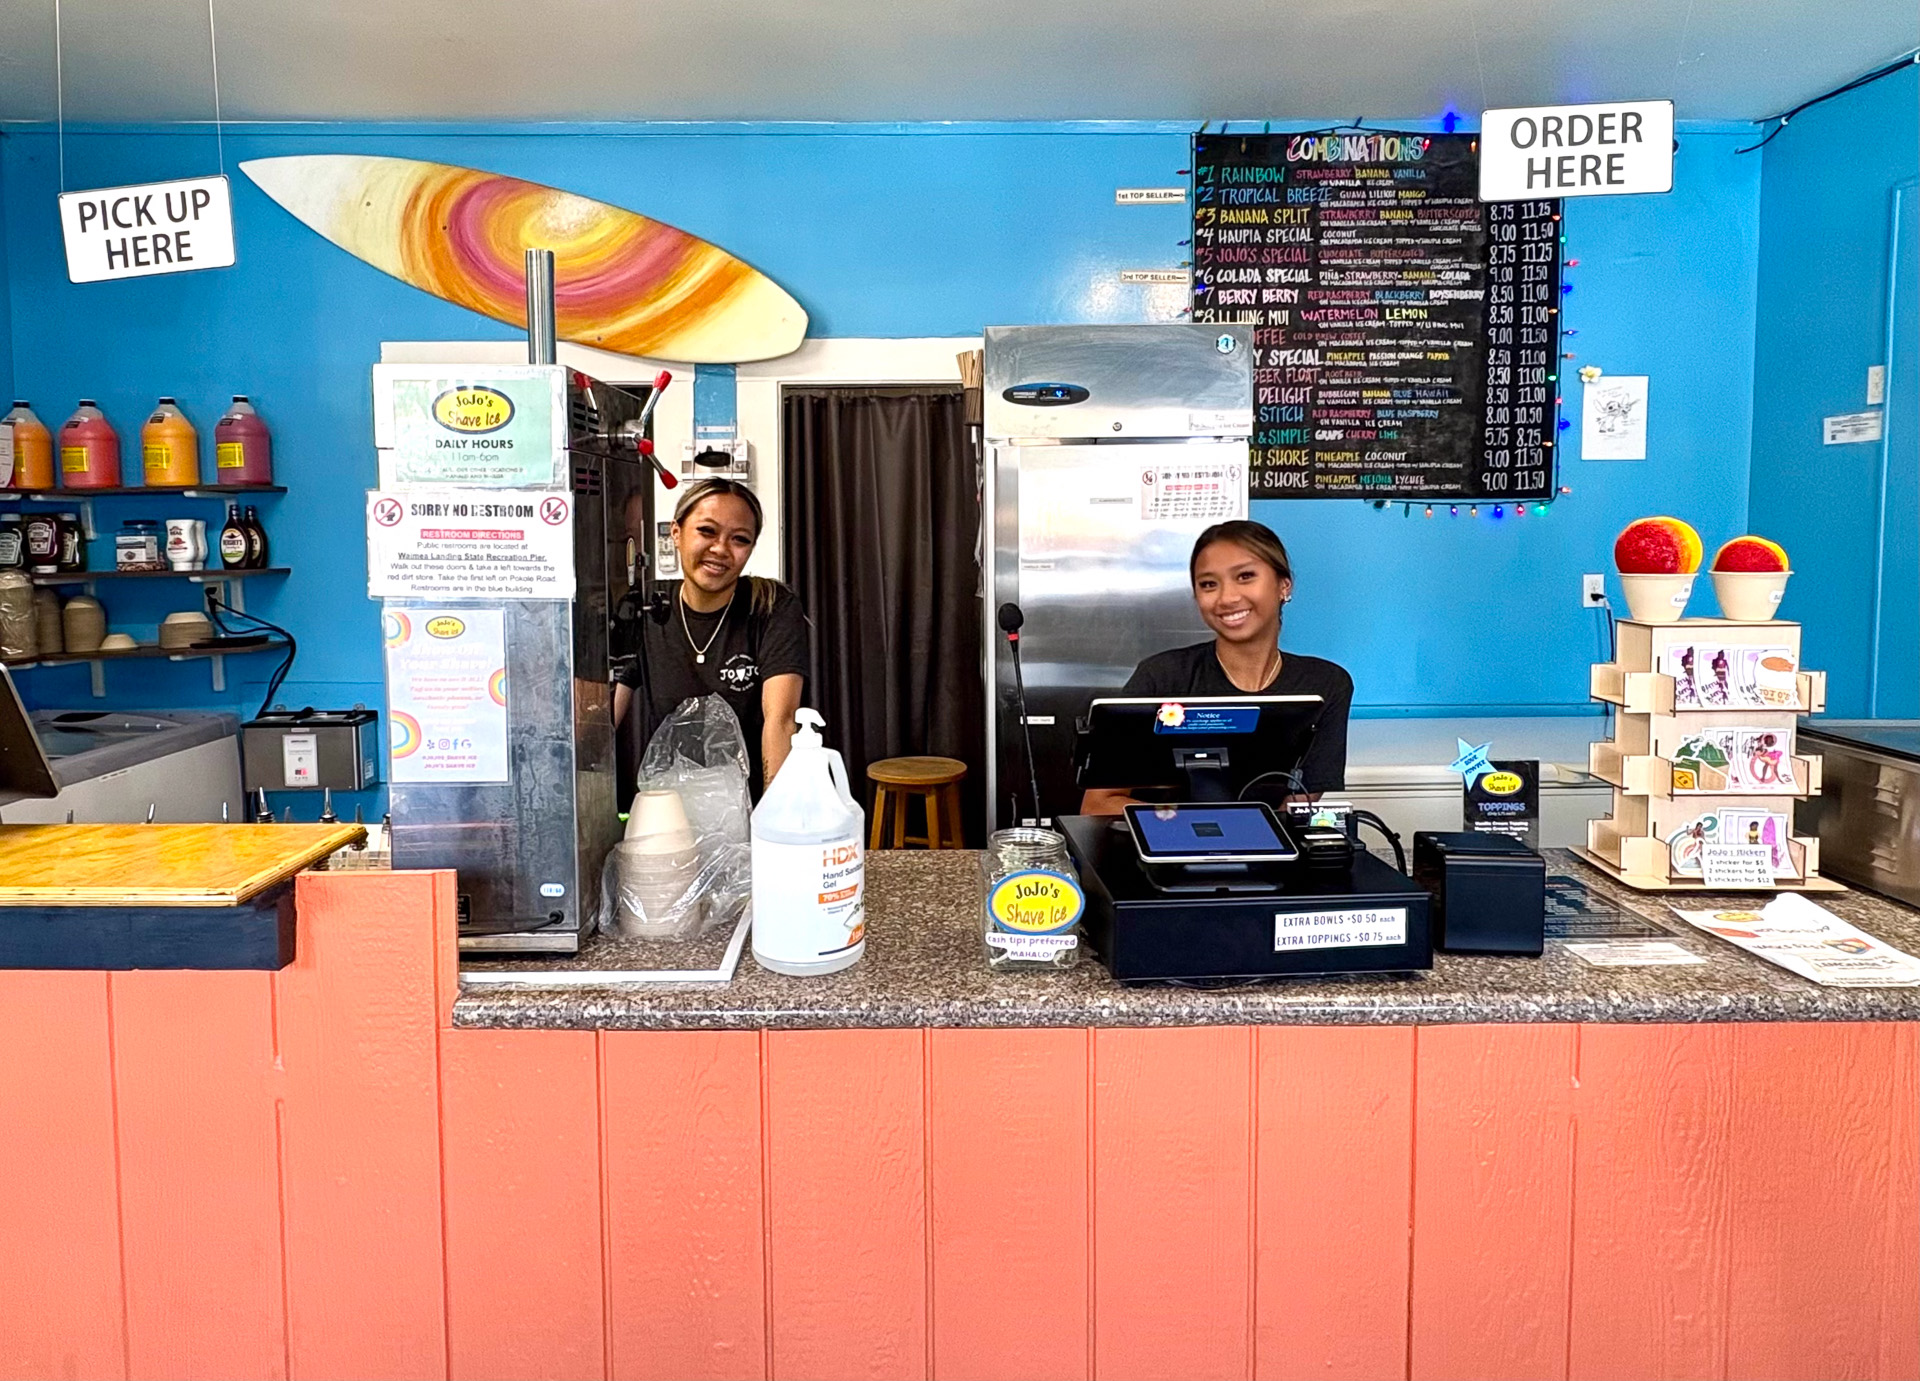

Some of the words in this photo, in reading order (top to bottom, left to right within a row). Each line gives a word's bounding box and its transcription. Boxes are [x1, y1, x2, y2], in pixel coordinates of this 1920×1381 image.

[1510, 111, 1643, 149] ORDER
[1287, 135, 1425, 162] COMBINATIONS
[1197, 165, 1215, 184] #1
[1222, 167, 1285, 183] RAINBOW
[1296, 169, 1352, 179] STRAWBERRY
[1355, 168, 1390, 178] BANANA
[1393, 169, 1426, 179] VANILLA
[1527, 153, 1624, 189] HERE
[1196, 186, 1215, 202] #2
[1219, 188, 1280, 205] TROPICAL
[1287, 186, 1334, 203] BREEZE
[1398, 191, 1426, 199] MANGO
[78, 195, 157, 233] PICK
[165, 189, 210, 222] UP
[1196, 207, 1216, 226] #3
[1220, 209, 1269, 224] BANANA
[1274, 207, 1311, 224] SPLIT
[1320, 211, 1376, 219] STRAWBERRY
[1380, 210, 1414, 219] BANANA
[1417, 209, 1480, 219] BUTTERSCOTCH
[1490, 205, 1514, 220] 8.75
[1521, 202, 1551, 219] 11.25
[1196, 228, 1214, 246] #4
[1219, 229, 1262, 244] HAUPIA
[1266, 228, 1314, 243] SPECIAL
[1323, 230, 1358, 238] COCONUT
[1490, 224, 1516, 242] 9.00
[1522, 222, 1554, 240] 11.50
[105, 231, 193, 270] HERE
[1196, 248, 1213, 265] #5
[1217, 248, 1257, 263] JOJO'S
[1262, 248, 1311, 264] SPECIAL
[1319, 250, 1363, 258] CHOCOLATE
[1489, 245, 1516, 264] 8.75
[1521, 243, 1553, 262] 11.25
[1195, 267, 1214, 284] #6
[1217, 268, 1261, 283] COLADA
[1266, 268, 1313, 283] SPECIAL
[1489, 267, 1513, 282] 9.00
[1521, 265, 1548, 281] 11.50
[1218, 289, 1257, 305] BERRY
[1262, 289, 1299, 304] BERRY
[1307, 291, 1323, 299] RED
[1326, 291, 1370, 299] RASPBERRY
[1375, 291, 1425, 299] BLACKBERRY
[1490, 284, 1514, 304] 8.50
[1521, 283, 1548, 303] 11.00
[1268, 311, 1289, 326] MUI
[1301, 309, 1378, 320] WATERMELON
[1386, 309, 1428, 319] LEMON
[1489, 305, 1513, 324] 8.50
[1521, 306, 1548, 325] 11.00
[1341, 332, 1367, 340] COFFEE
[1488, 328, 1512, 344] 9.00
[1520, 328, 1548, 344] 11.50
[1269, 349, 1324, 366] SPECIAL
[1327, 352, 1365, 360] PINEAPPLE
[1488, 349, 1510, 365] 8.50
[1520, 349, 1546, 365] 11.00
[1286, 367, 1322, 384] FLOAT
[1487, 367, 1510, 385] 8.50
[1518, 367, 1545, 385] 11.00
[456, 394, 494, 407] JoJo's
[1259, 386, 1313, 404] DELIGHT
[1319, 390, 1359, 398] BUBBLEGUM
[1486, 387, 1509, 404] 8.50
[1518, 387, 1546, 404] 11.00
[448, 411, 481, 427] Shave
[486, 412, 500, 425] Ice
[1259, 407, 1304, 423] STITCH
[1329, 410, 1371, 418] RASPBERRY
[1377, 410, 1395, 418] BLUE
[1397, 410, 1439, 419] RASPBERRY
[1486, 406, 1509, 424] 8.00
[1514, 407, 1542, 424] 10.50
[436, 440, 468, 448] DAILY
[472, 440, 513, 448] HOURS
[1268, 428, 1310, 445] SIMPLE
[1346, 430, 1377, 438] CHERRY
[1485, 427, 1510, 446] 5.75
[1517, 428, 1541, 447] 8.25
[452, 452, 499, 462] 11am-6pm
[1267, 449, 1310, 467] SHORE
[1315, 452, 1360, 461] PINEAPPLE
[1365, 452, 1407, 461] COCONUT
[1484, 450, 1509, 468] 9.00
[1514, 448, 1543, 467] 11.50
[1264, 471, 1310, 488] SHORE
[1315, 475, 1357, 483] PINEAPPLE
[1395, 475, 1425, 484] LYCHEE
[1482, 473, 1507, 491] 9.00
[1514, 471, 1544, 490] 11.50
[411, 504, 449, 516] SORRY
[453, 504, 468, 516] NO
[431, 553, 462, 561] Landing
[505, 586, 532, 594] building
[1478, 803, 1525, 811] TOPPINGS
[823, 842, 859, 867] HDX
[823, 870, 844, 880] Hand
[823, 880, 837, 889] Gel
[1015, 882, 1060, 899] JoJo's
[1006, 903, 1045, 925] Shave
[1050, 905, 1067, 924] Ice
[1283, 917, 1310, 928] EXTRA
[1314, 915, 1344, 925] BOWLS
[1029, 938, 1076, 947] preferred
[1277, 935, 1304, 946] EXTRA
[1307, 933, 1351, 944] TOPPINGS
